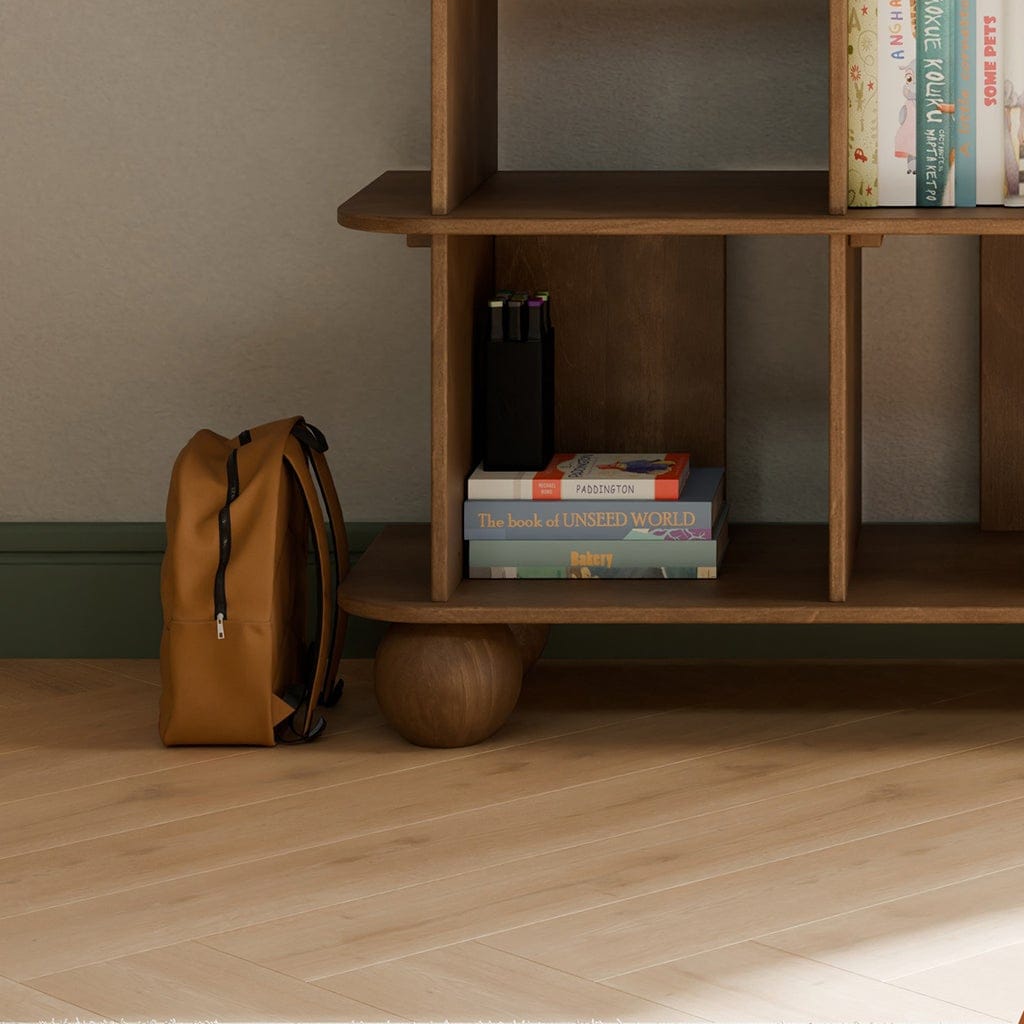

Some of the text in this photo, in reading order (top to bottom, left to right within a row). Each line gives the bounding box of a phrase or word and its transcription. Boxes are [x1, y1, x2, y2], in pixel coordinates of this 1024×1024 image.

[983, 15, 997, 107] SOME PETS
[923, 58, 946, 124] КОШКИ
[575, 483, 635, 495] PADDINGTON
[478, 513, 504, 528] The
[507, 513, 543, 528] book
[545, 513, 560, 528] of
[630, 511, 696, 527] WORLD
[569, 550, 614, 569] Bakery
